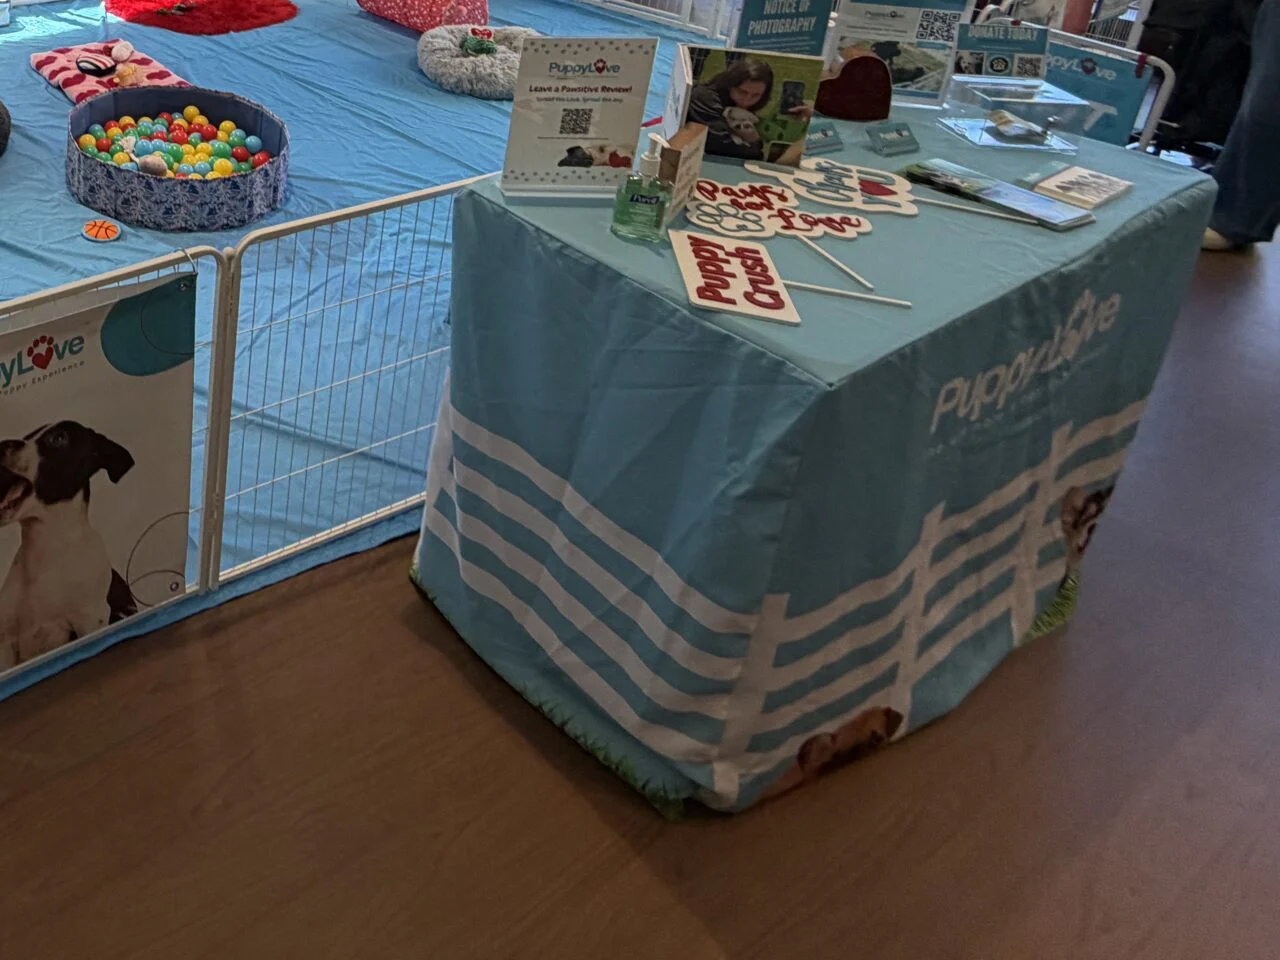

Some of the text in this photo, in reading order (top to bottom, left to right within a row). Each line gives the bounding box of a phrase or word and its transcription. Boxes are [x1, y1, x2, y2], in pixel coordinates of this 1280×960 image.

[747, 17, 816, 36] PHOTOGRAPHY
[529, 85, 552, 93] Leave
[561, 85, 599, 93] Pawsitive
[600, 85, 633, 93] Review!
[696, 180, 788, 203] Paws
[768, 208, 861, 233] Love
[687, 235, 737, 306] Puppy
[726, 246, 786, 310] Crush
